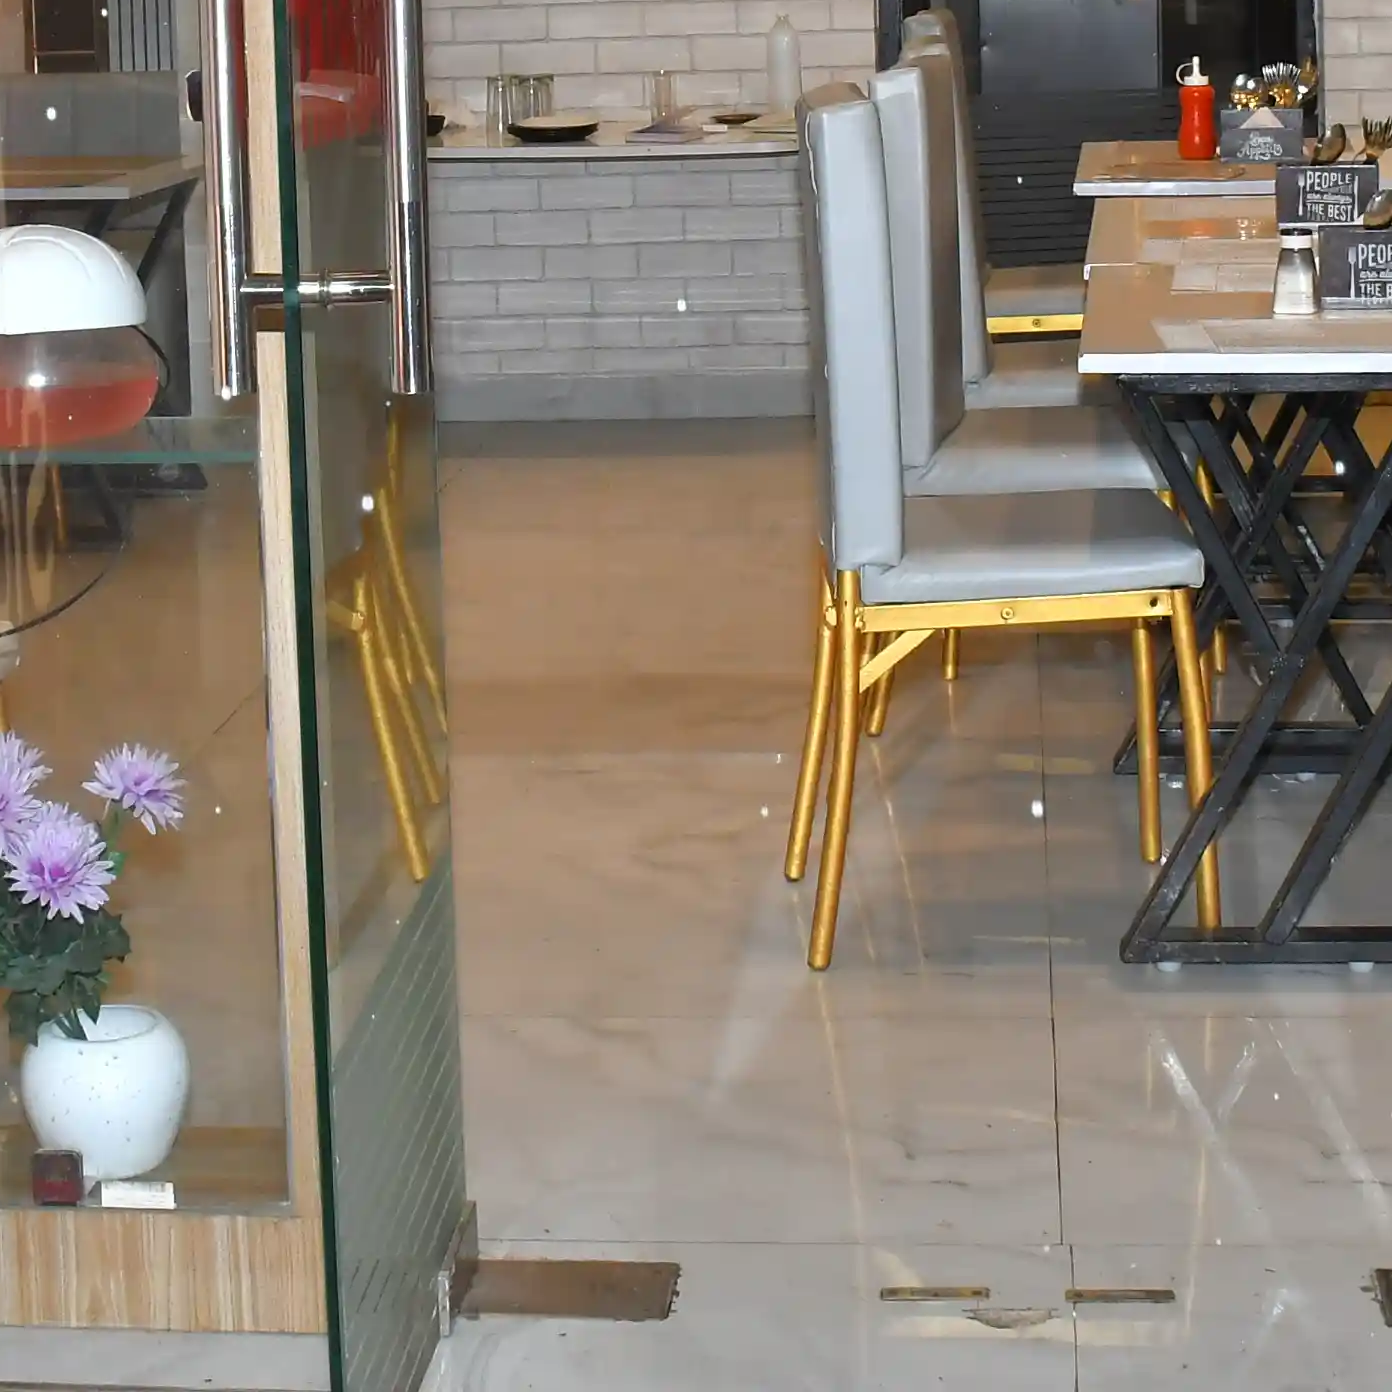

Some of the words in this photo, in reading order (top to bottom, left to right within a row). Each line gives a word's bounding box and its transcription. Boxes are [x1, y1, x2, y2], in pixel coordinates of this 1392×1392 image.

[1307, 171, 1353, 192] PEOPLE
[1307, 203, 1325, 215] THE
[1327, 204, 1353, 222] BEST
[1359, 283, 1382, 297] THE
